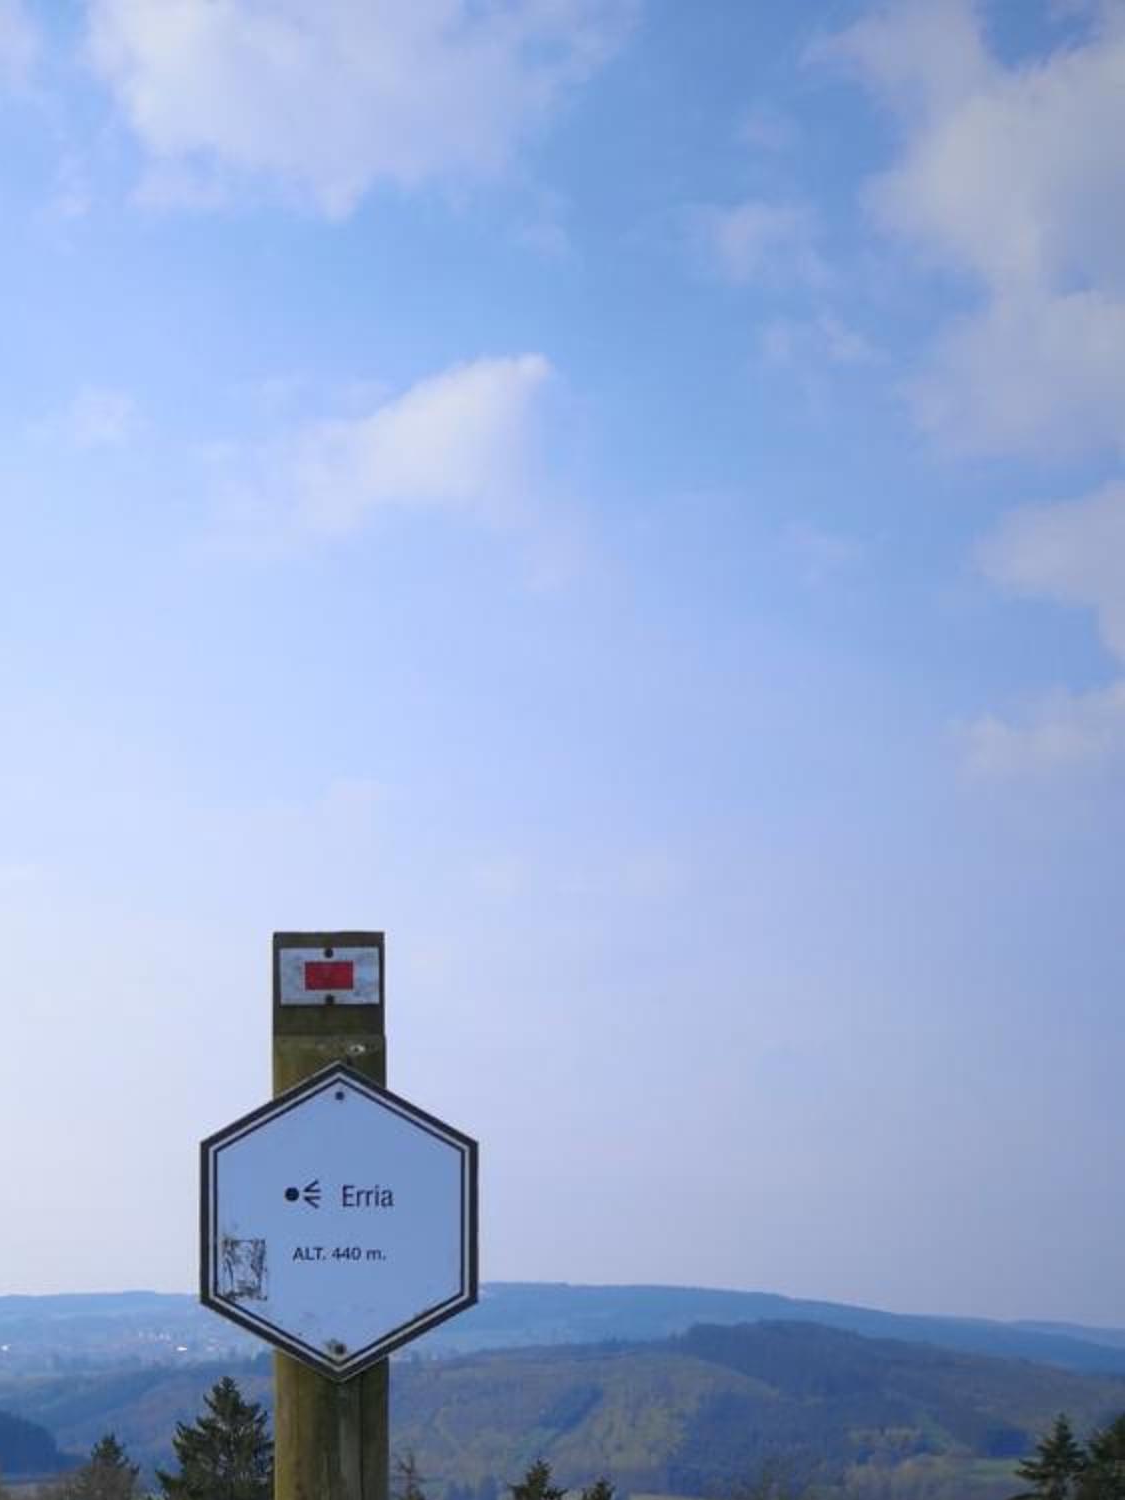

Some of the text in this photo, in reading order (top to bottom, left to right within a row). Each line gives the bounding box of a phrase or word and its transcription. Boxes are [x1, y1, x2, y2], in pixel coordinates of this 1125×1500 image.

[341, 1184, 394, 1208] Erria
[292, 1247, 386, 1261] ALT. 440 m.
